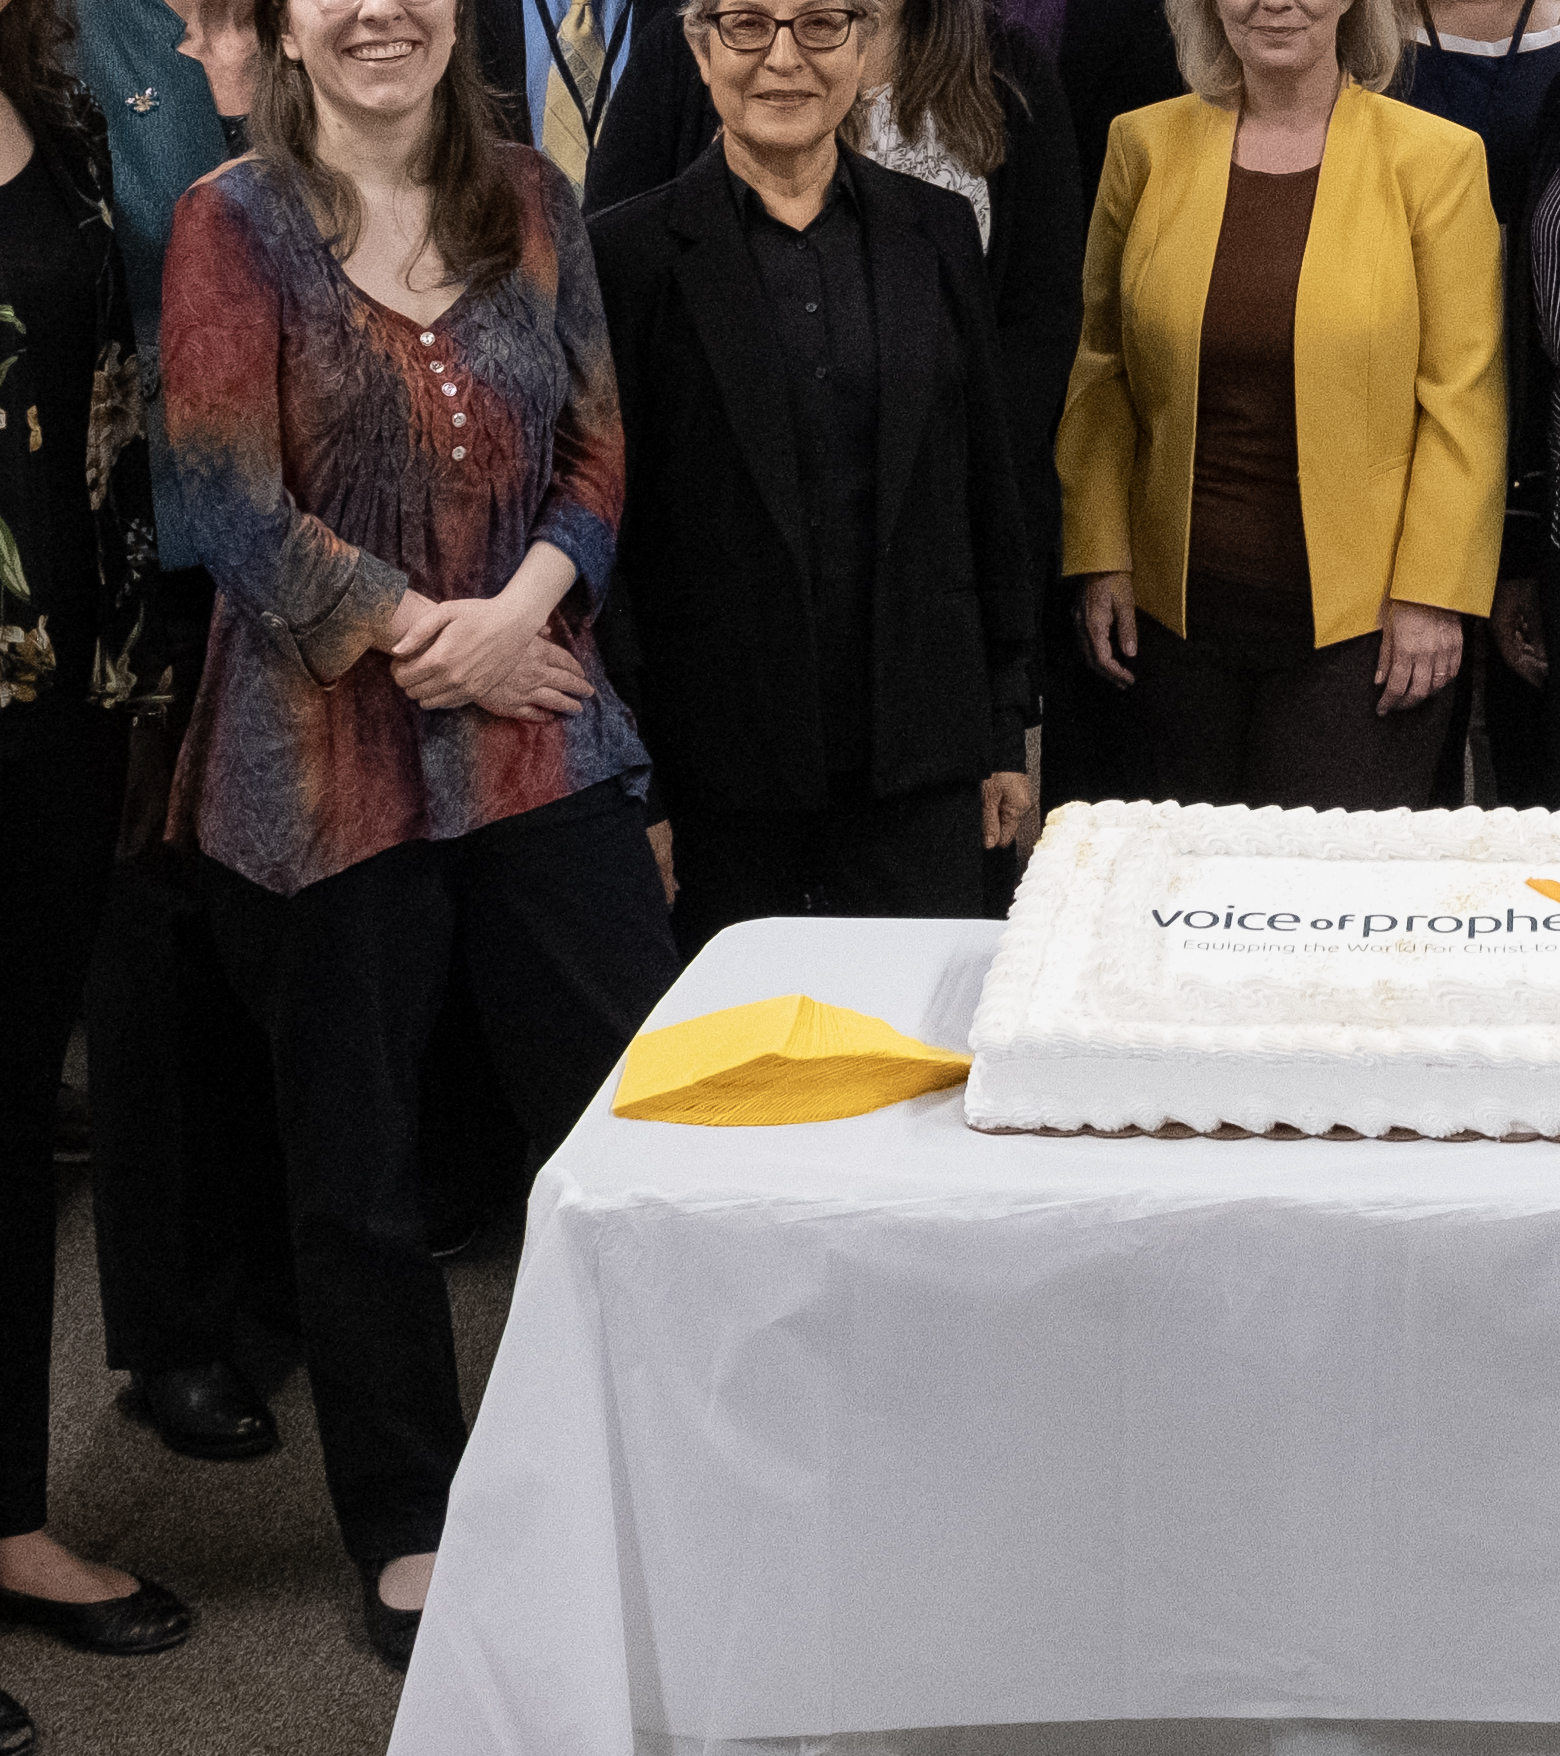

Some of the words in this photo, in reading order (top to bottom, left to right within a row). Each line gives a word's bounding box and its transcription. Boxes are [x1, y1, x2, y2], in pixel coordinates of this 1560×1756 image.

[1151, 905, 1301, 932] voice
[1310, 913, 1356, 931] of
[1183, 939, 1296, 954] Equipping
[1304, 942, 1340, 953] the
[1464, 942, 1527, 954] Christ
[1535, 942, 1558, 953] to
